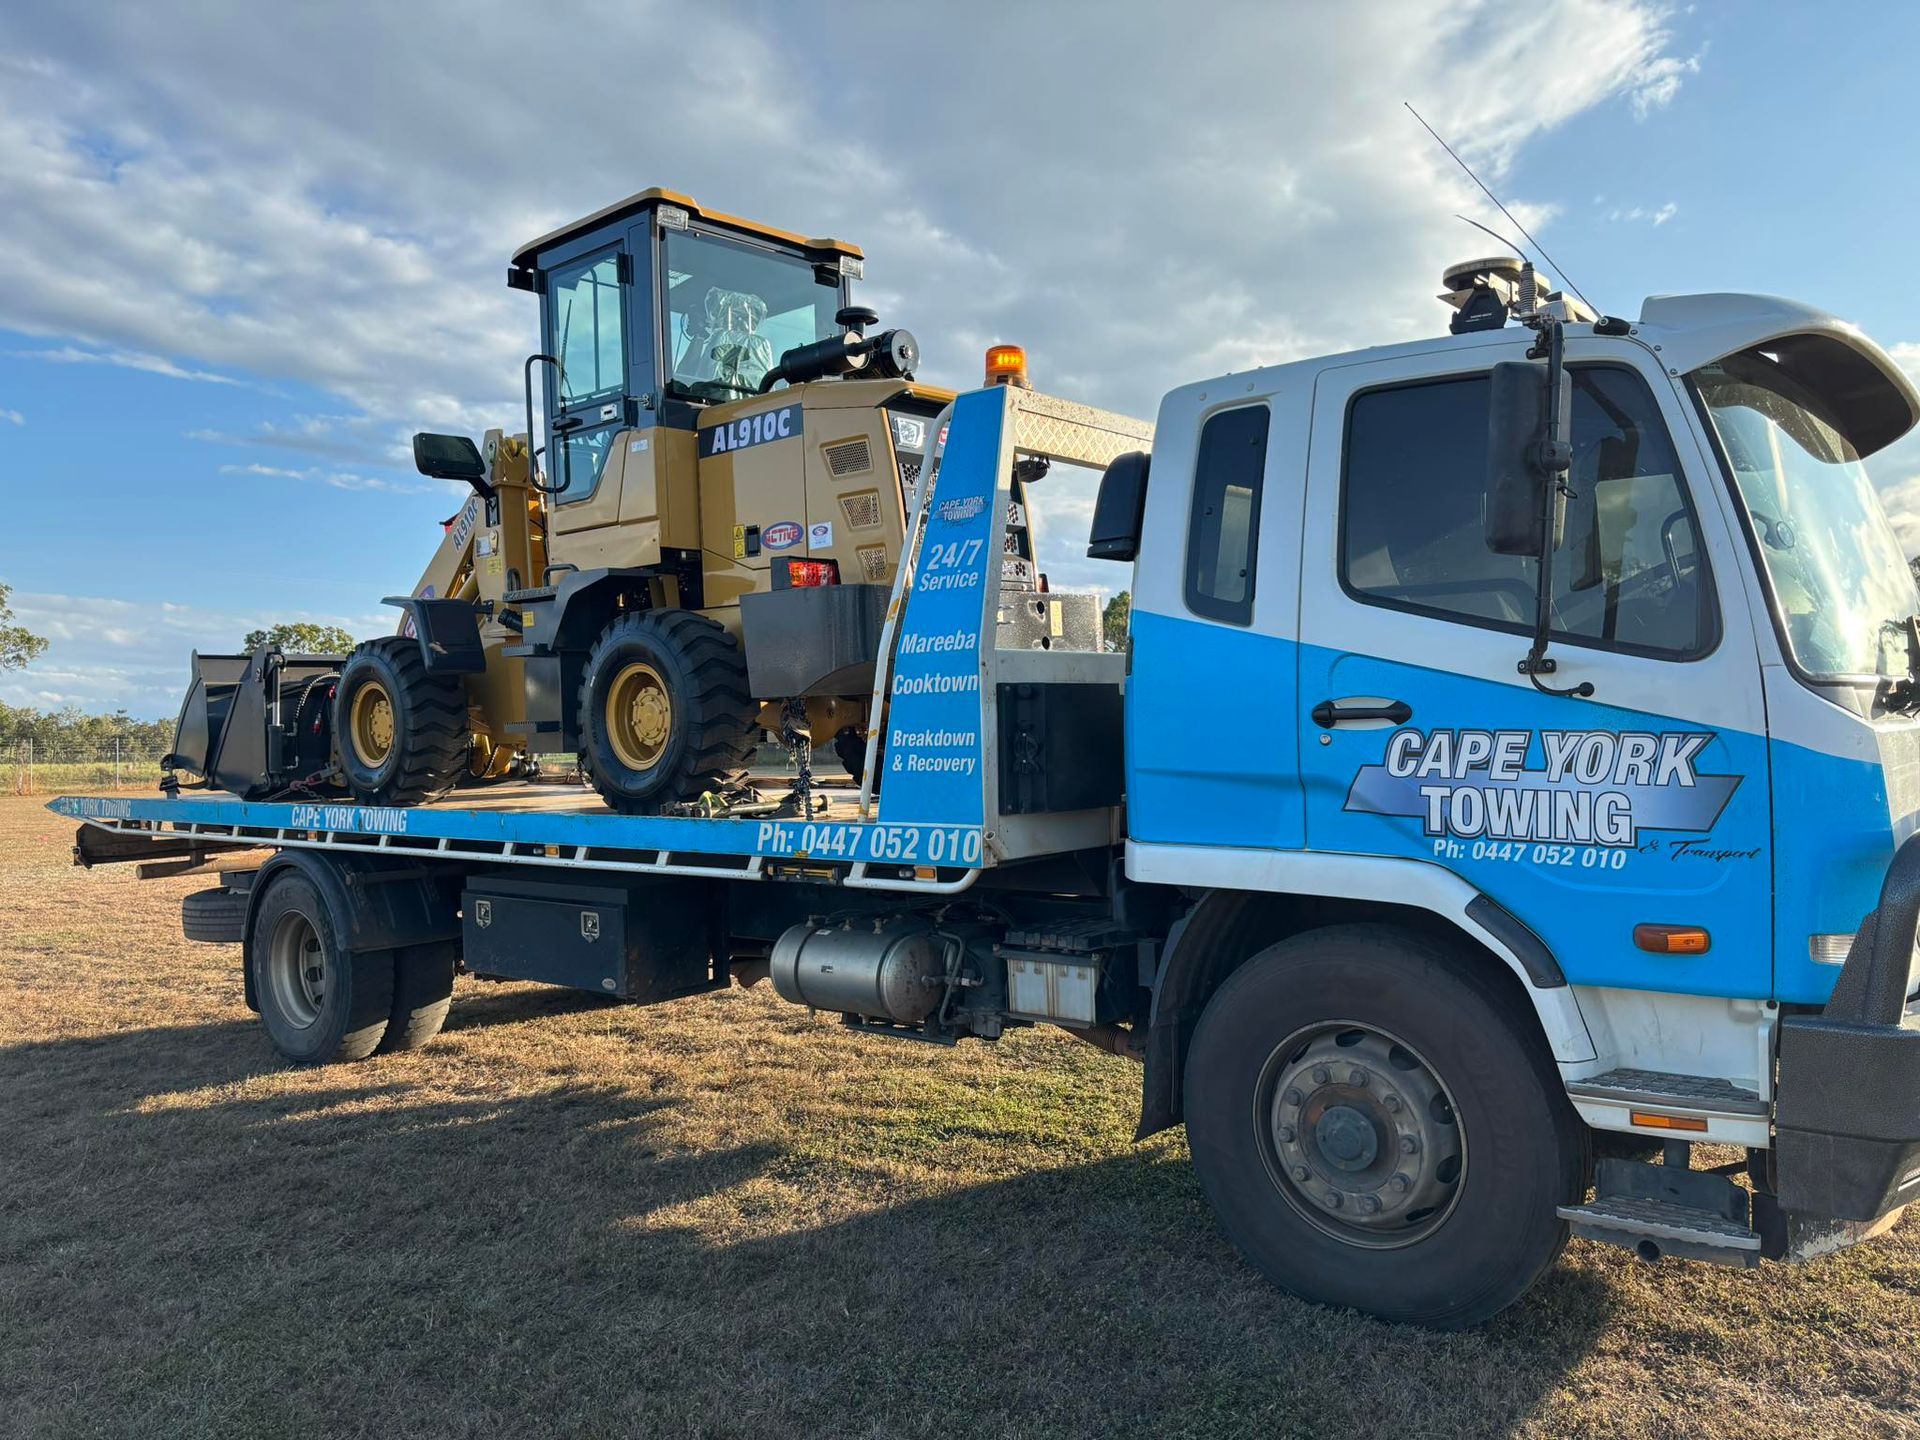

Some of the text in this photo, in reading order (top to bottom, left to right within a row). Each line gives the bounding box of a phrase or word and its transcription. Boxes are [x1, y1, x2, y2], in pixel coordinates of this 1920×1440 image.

[712, 408, 791, 453] AL910C
[926, 539, 984, 571] 24/7
[918, 569, 979, 592] Service
[900, 630, 976, 654] Mareeba
[893, 672, 979, 695] Cooktown
[892, 729, 976, 748] Breakdown
[892, 754, 976, 776] & Recovery
[1386, 730, 1706, 787] CAPE YORK
[291, 806, 408, 832] CAPE YORK TOWING
[1420, 786, 1634, 844] TOWING
[756, 823, 981, 863] Ph: 0447 052 010
[1433, 838, 1628, 870] Ph: 0447 052 010
[1669, 838, 1761, 862] Transport
